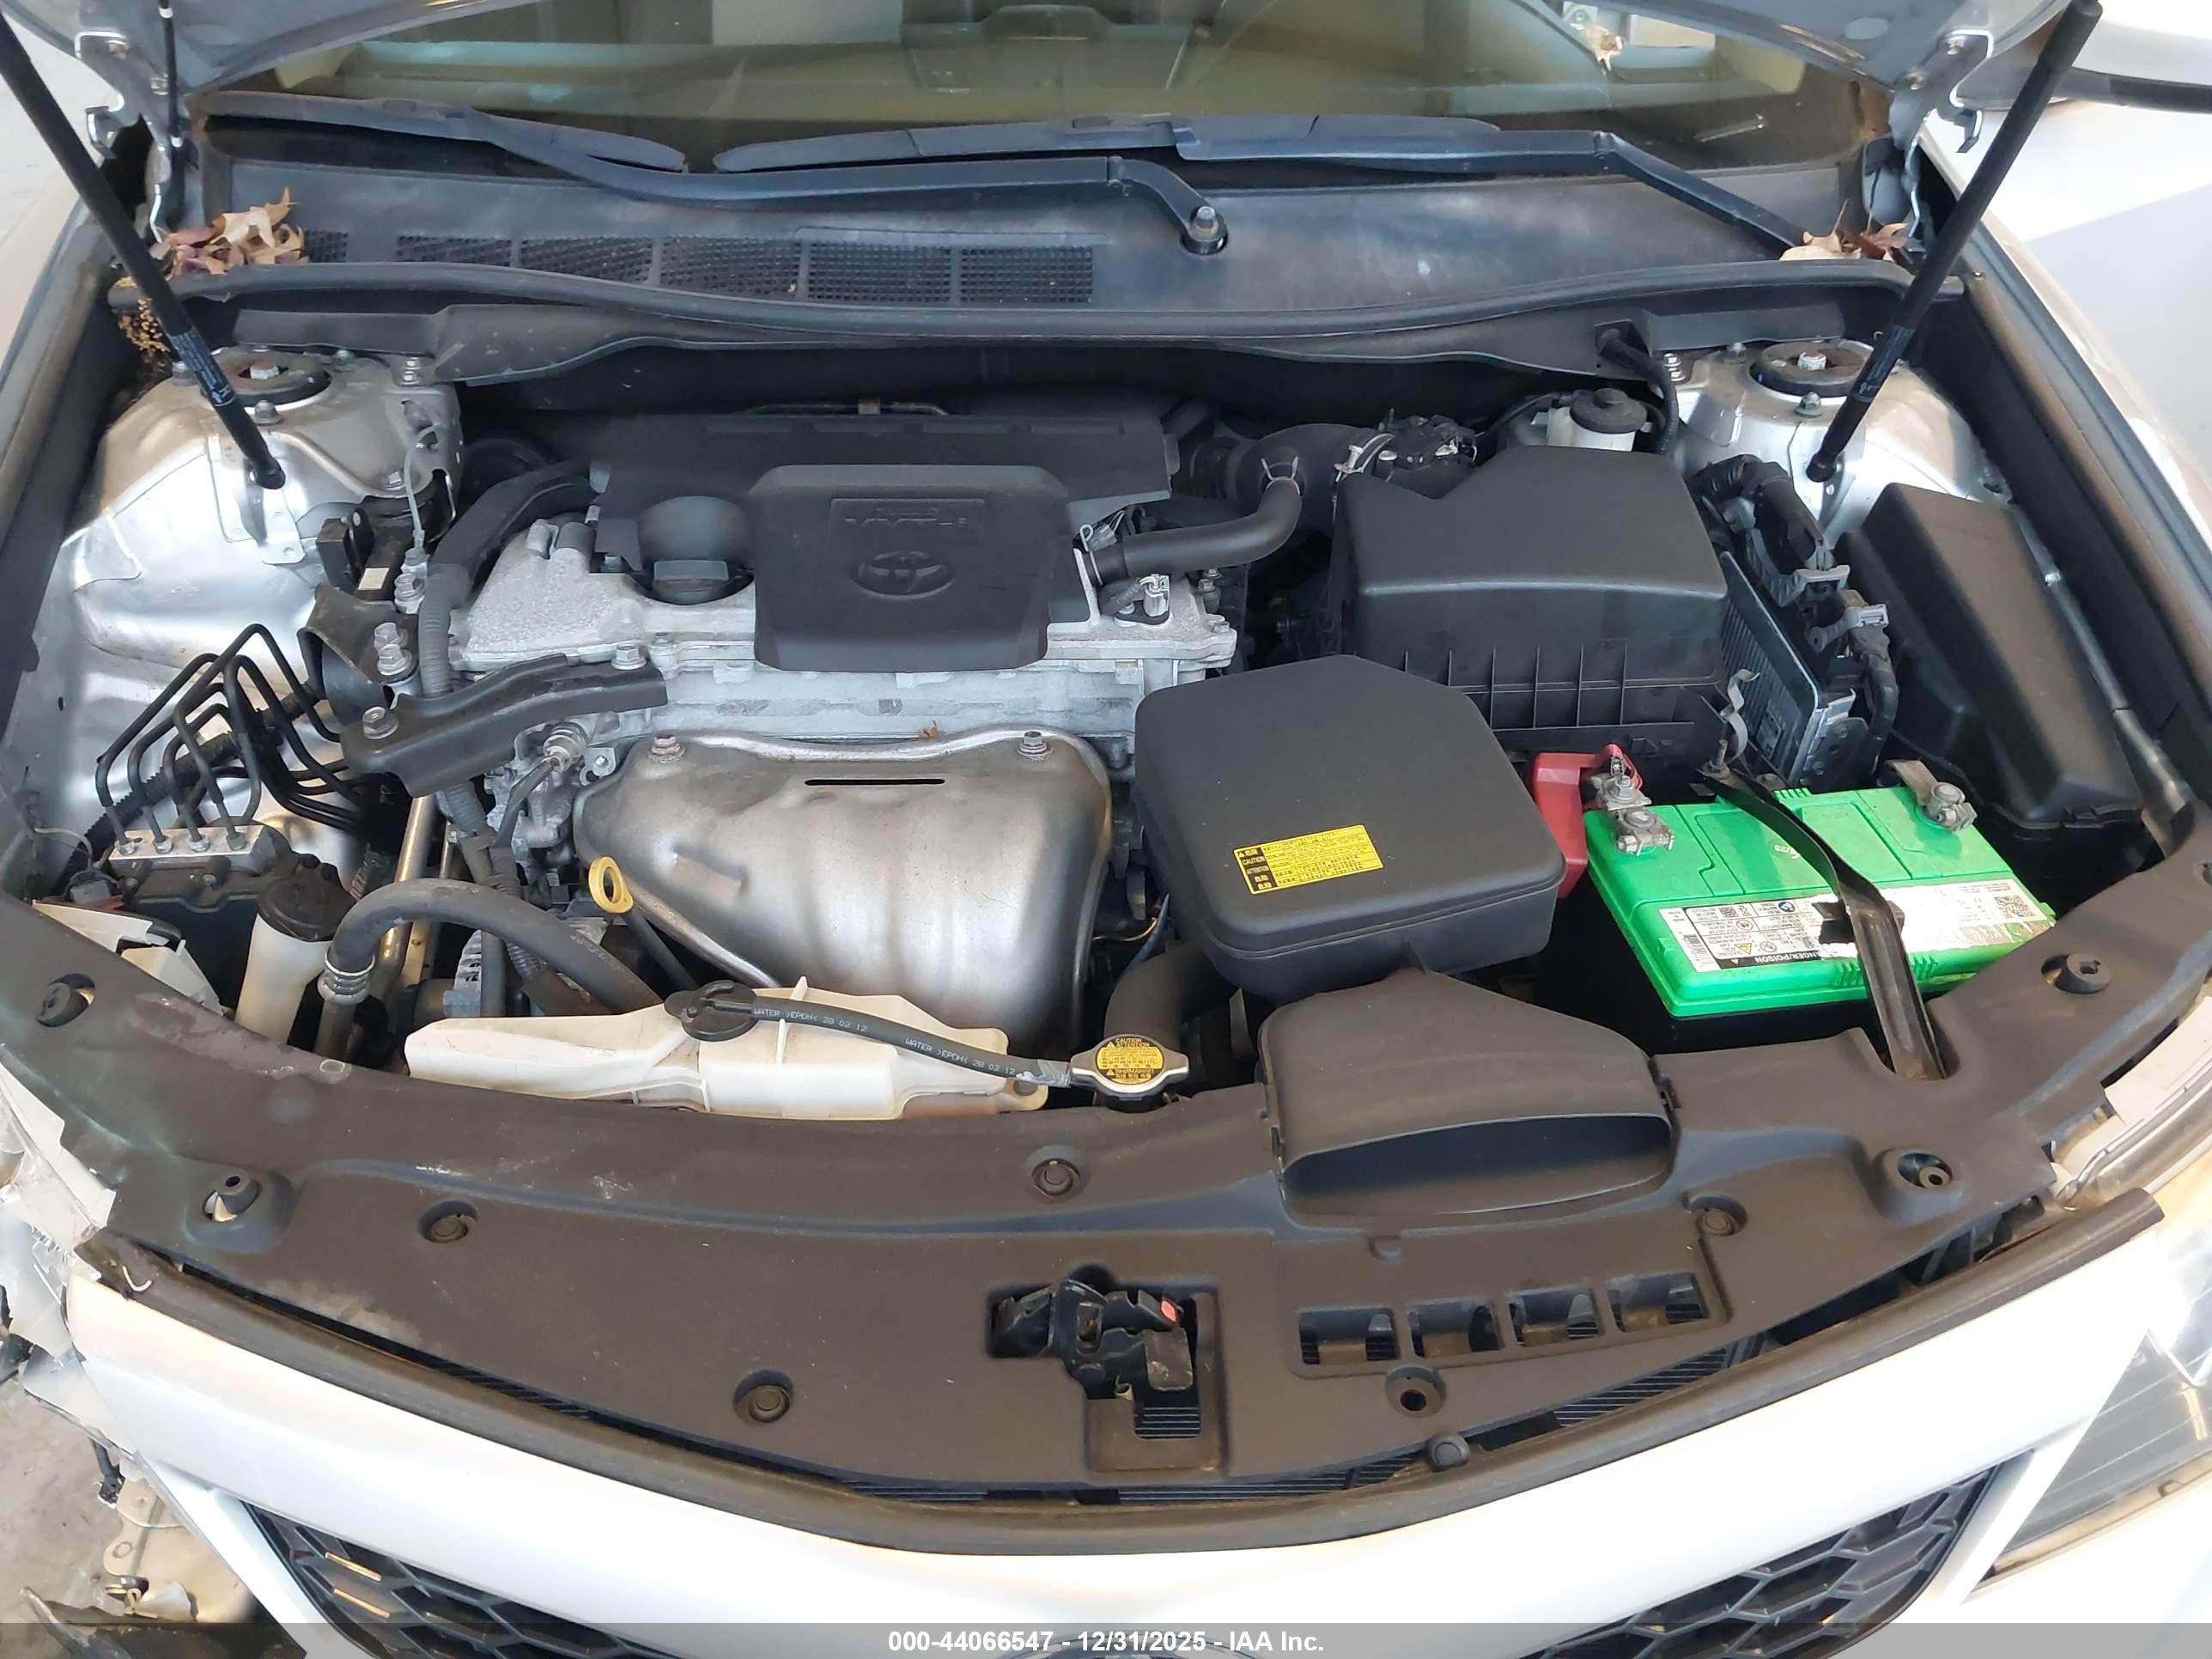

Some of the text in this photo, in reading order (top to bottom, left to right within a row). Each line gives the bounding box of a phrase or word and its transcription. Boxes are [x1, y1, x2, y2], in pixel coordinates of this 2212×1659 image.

[1754, 951, 1820, 963] ANGER/POISON
[754, 1008, 781, 1018] WATER
[905, 1037, 933, 1052] WATER
